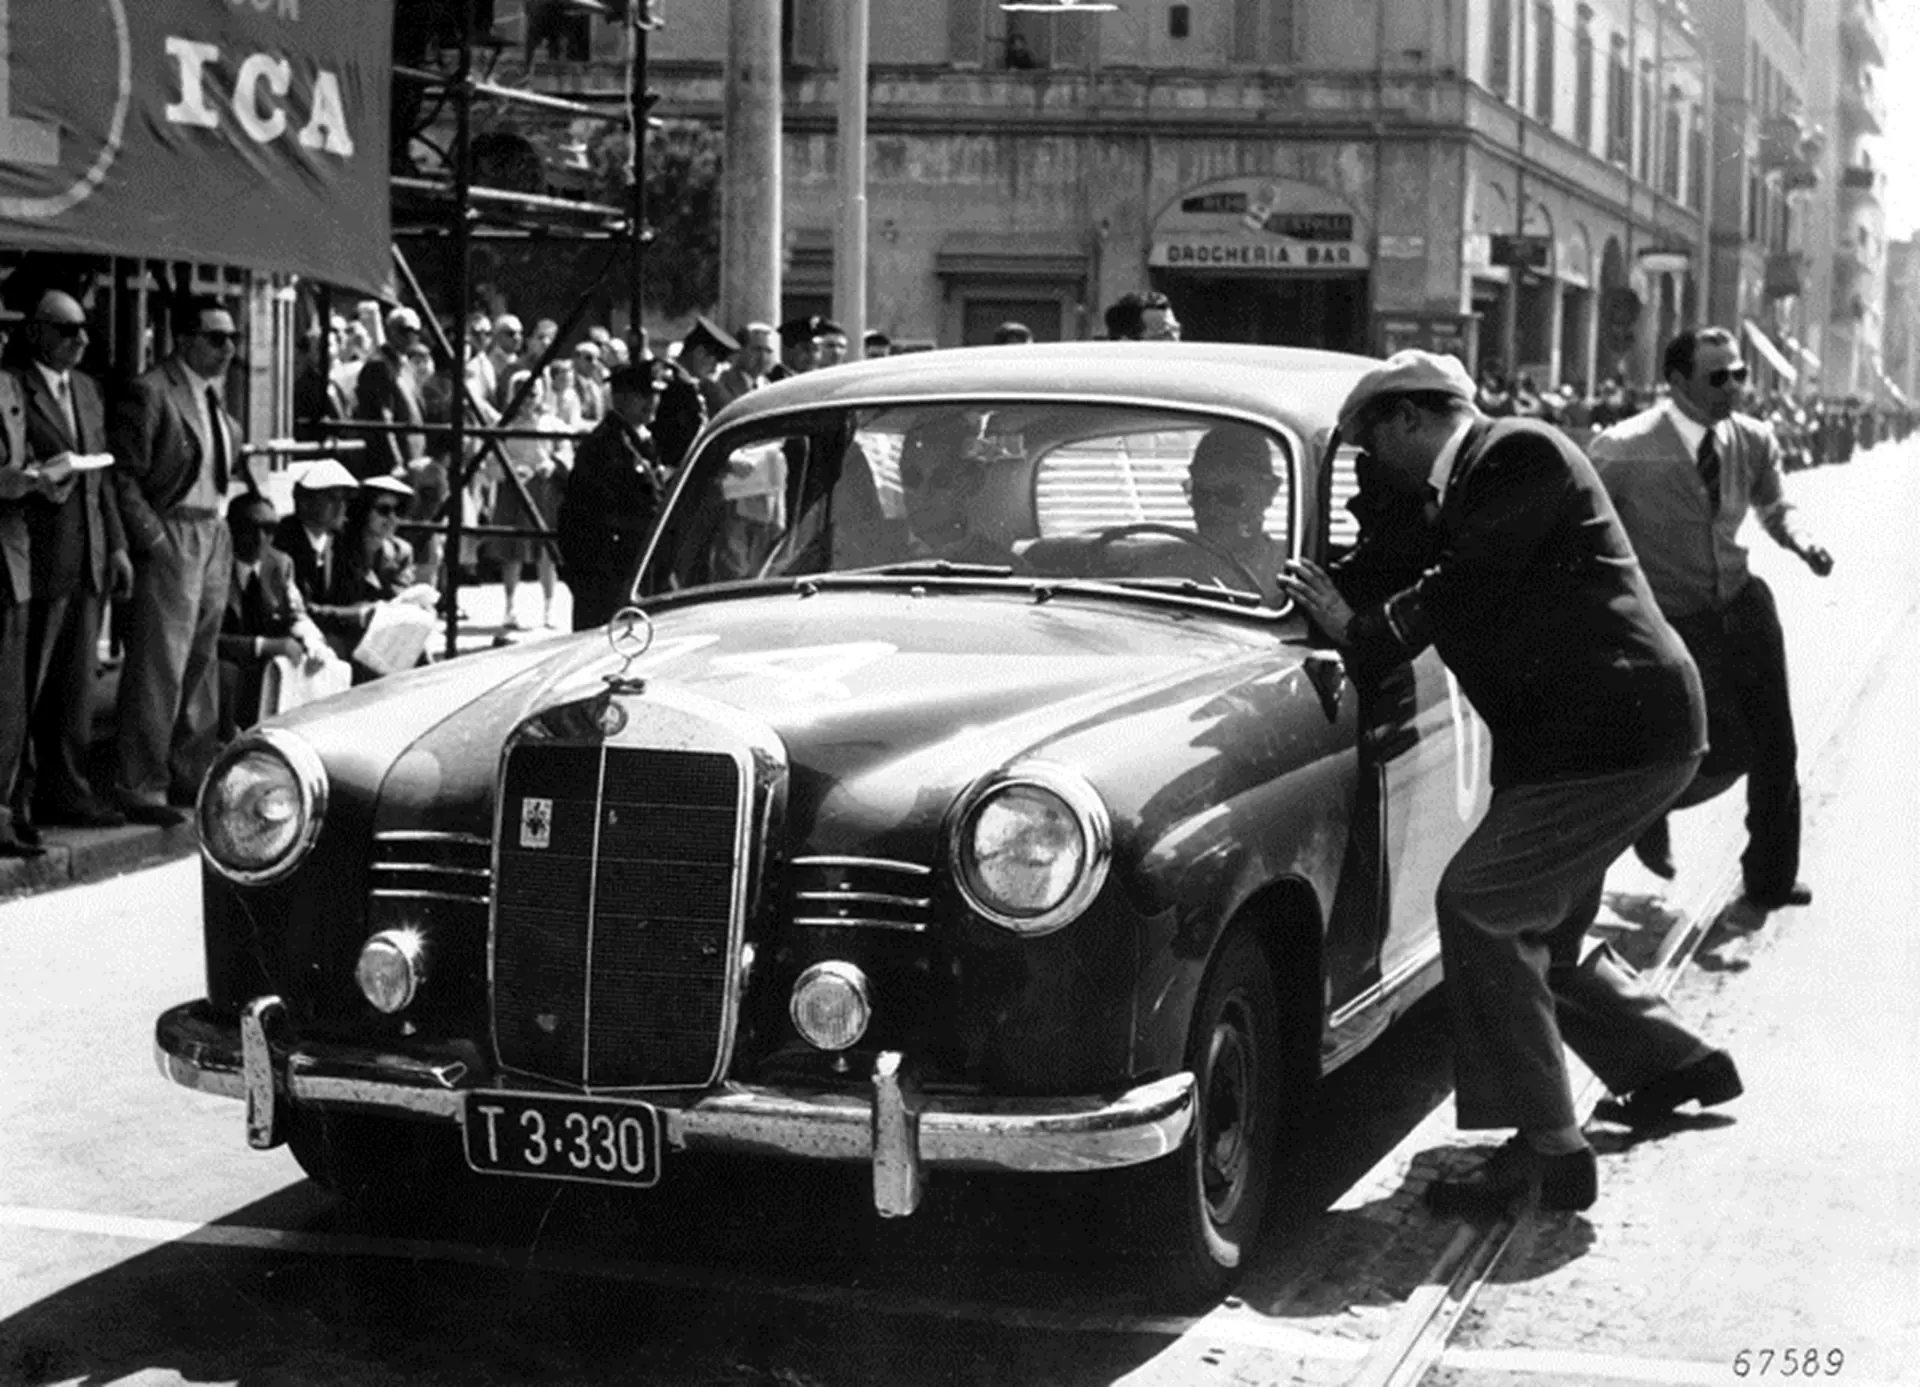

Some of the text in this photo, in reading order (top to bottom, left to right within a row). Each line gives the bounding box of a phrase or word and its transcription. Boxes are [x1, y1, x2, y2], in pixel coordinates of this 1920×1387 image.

[165, 36, 353, 156] ICA
[1167, 245, 1350, 264] DROGHERIA BAR
[478, 1106, 504, 1162] T
